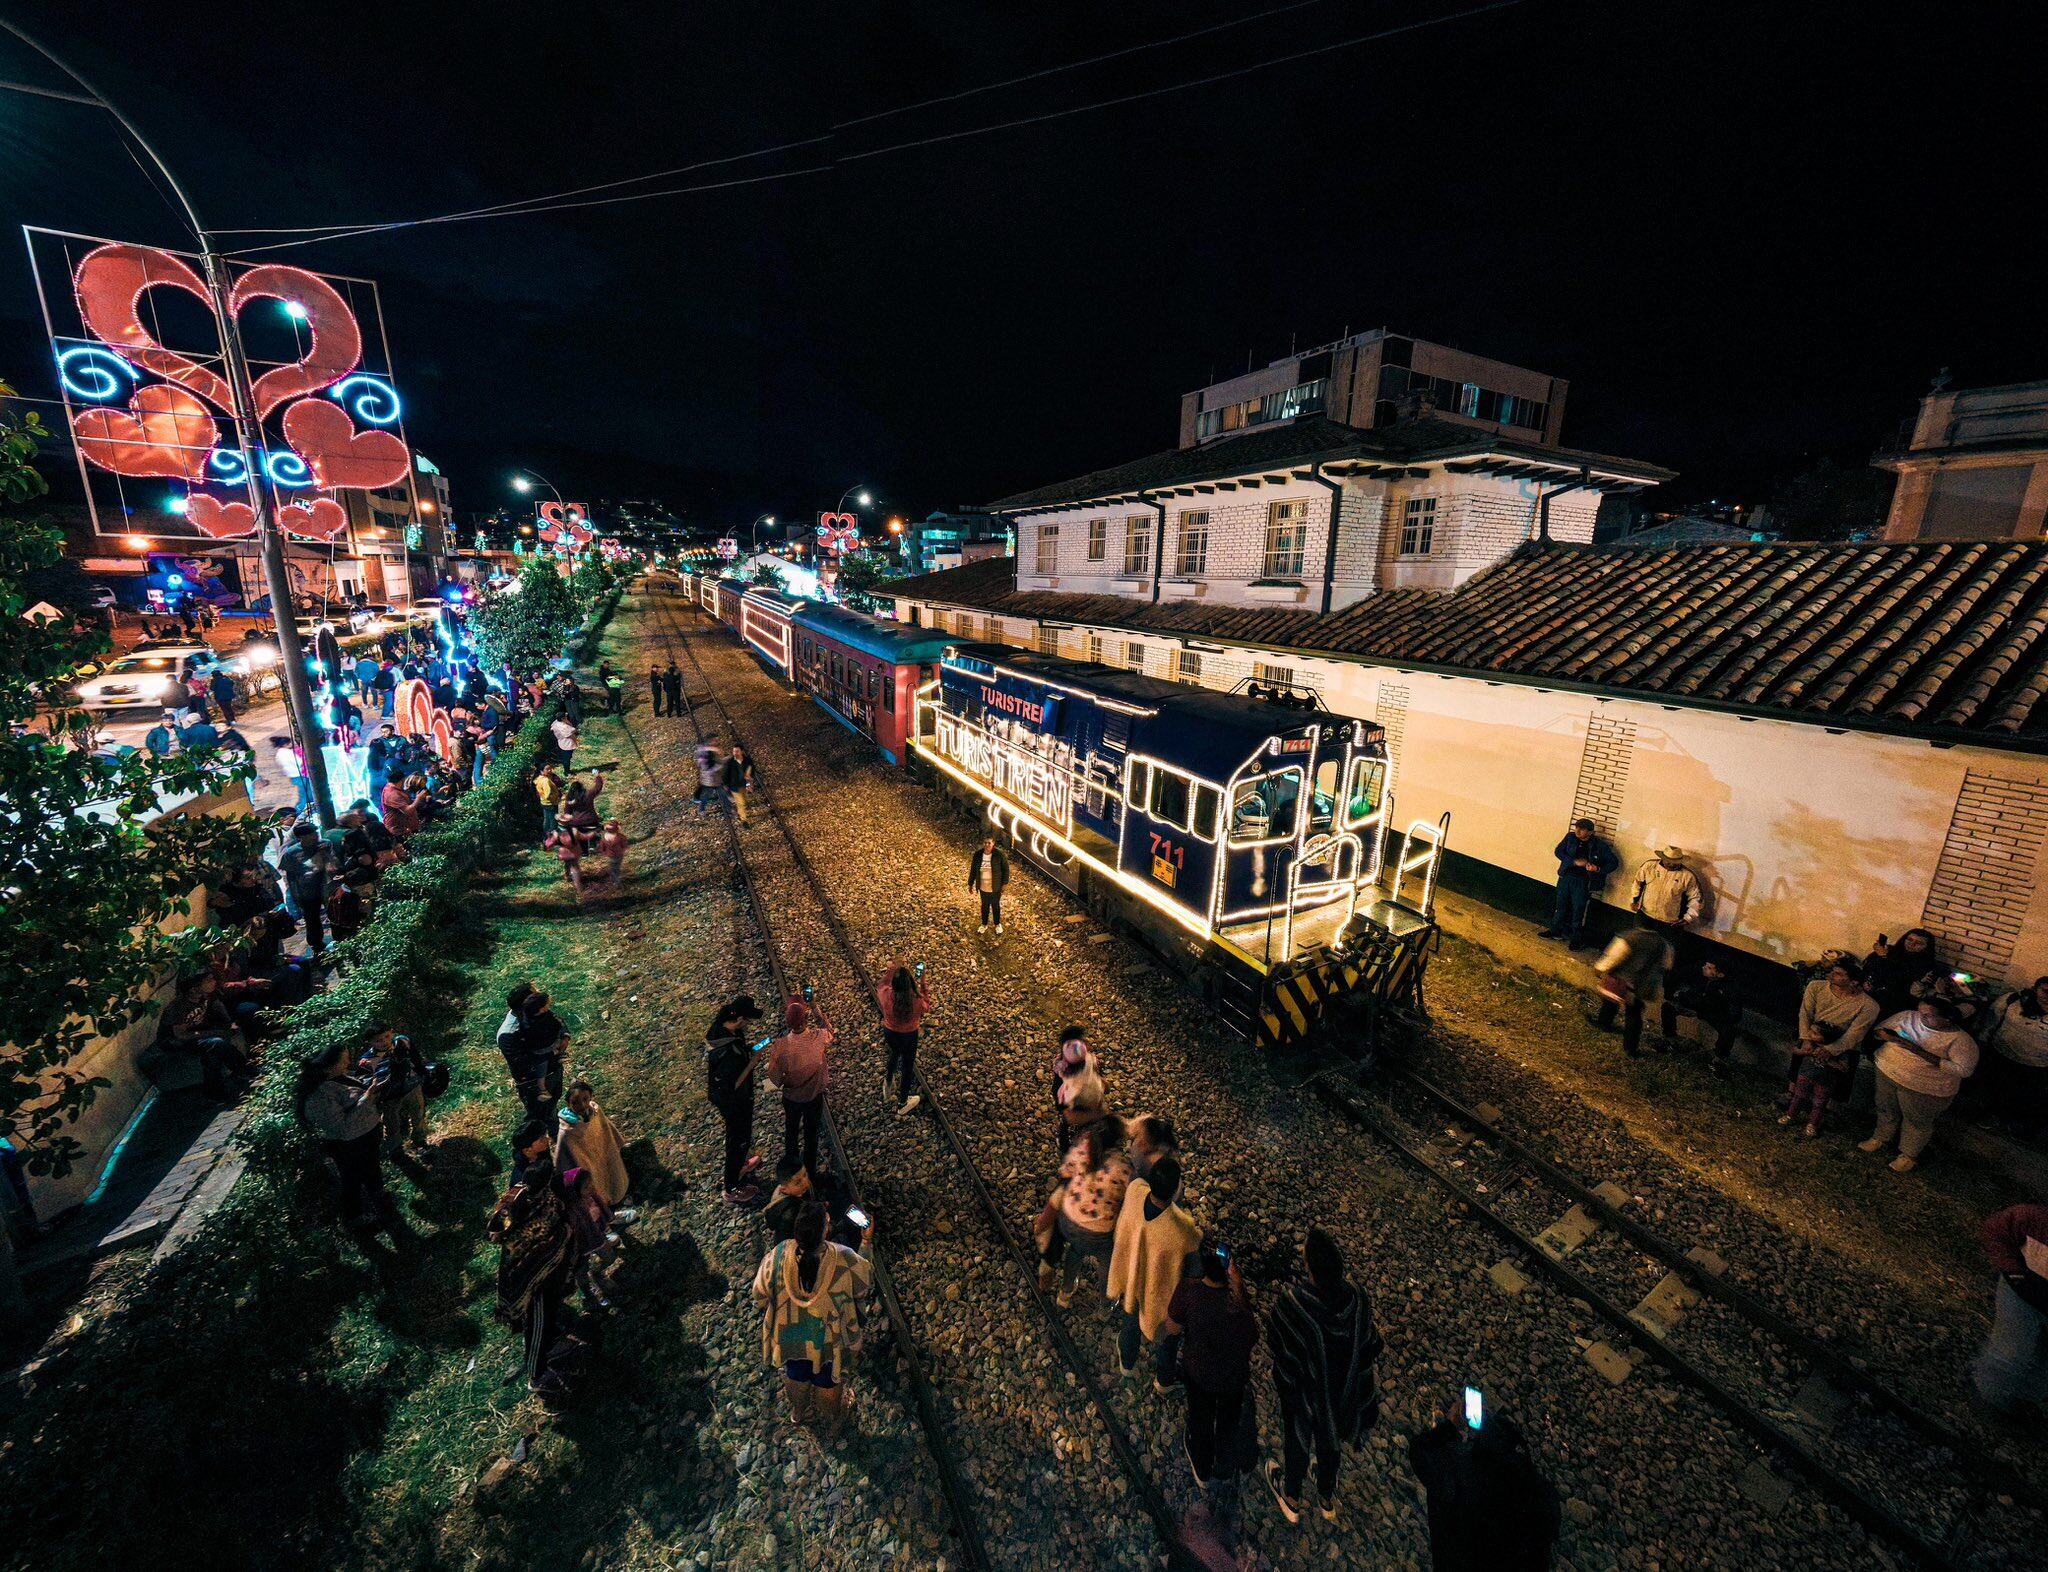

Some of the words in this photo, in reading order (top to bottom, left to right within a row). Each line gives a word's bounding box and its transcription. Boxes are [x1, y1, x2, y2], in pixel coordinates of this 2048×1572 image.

[1286, 740, 1310, 752] 711
[1367, 731, 1382, 741] 711
[939, 719, 1067, 825] TURISTREN
[1149, 831, 1184, 870] 711
